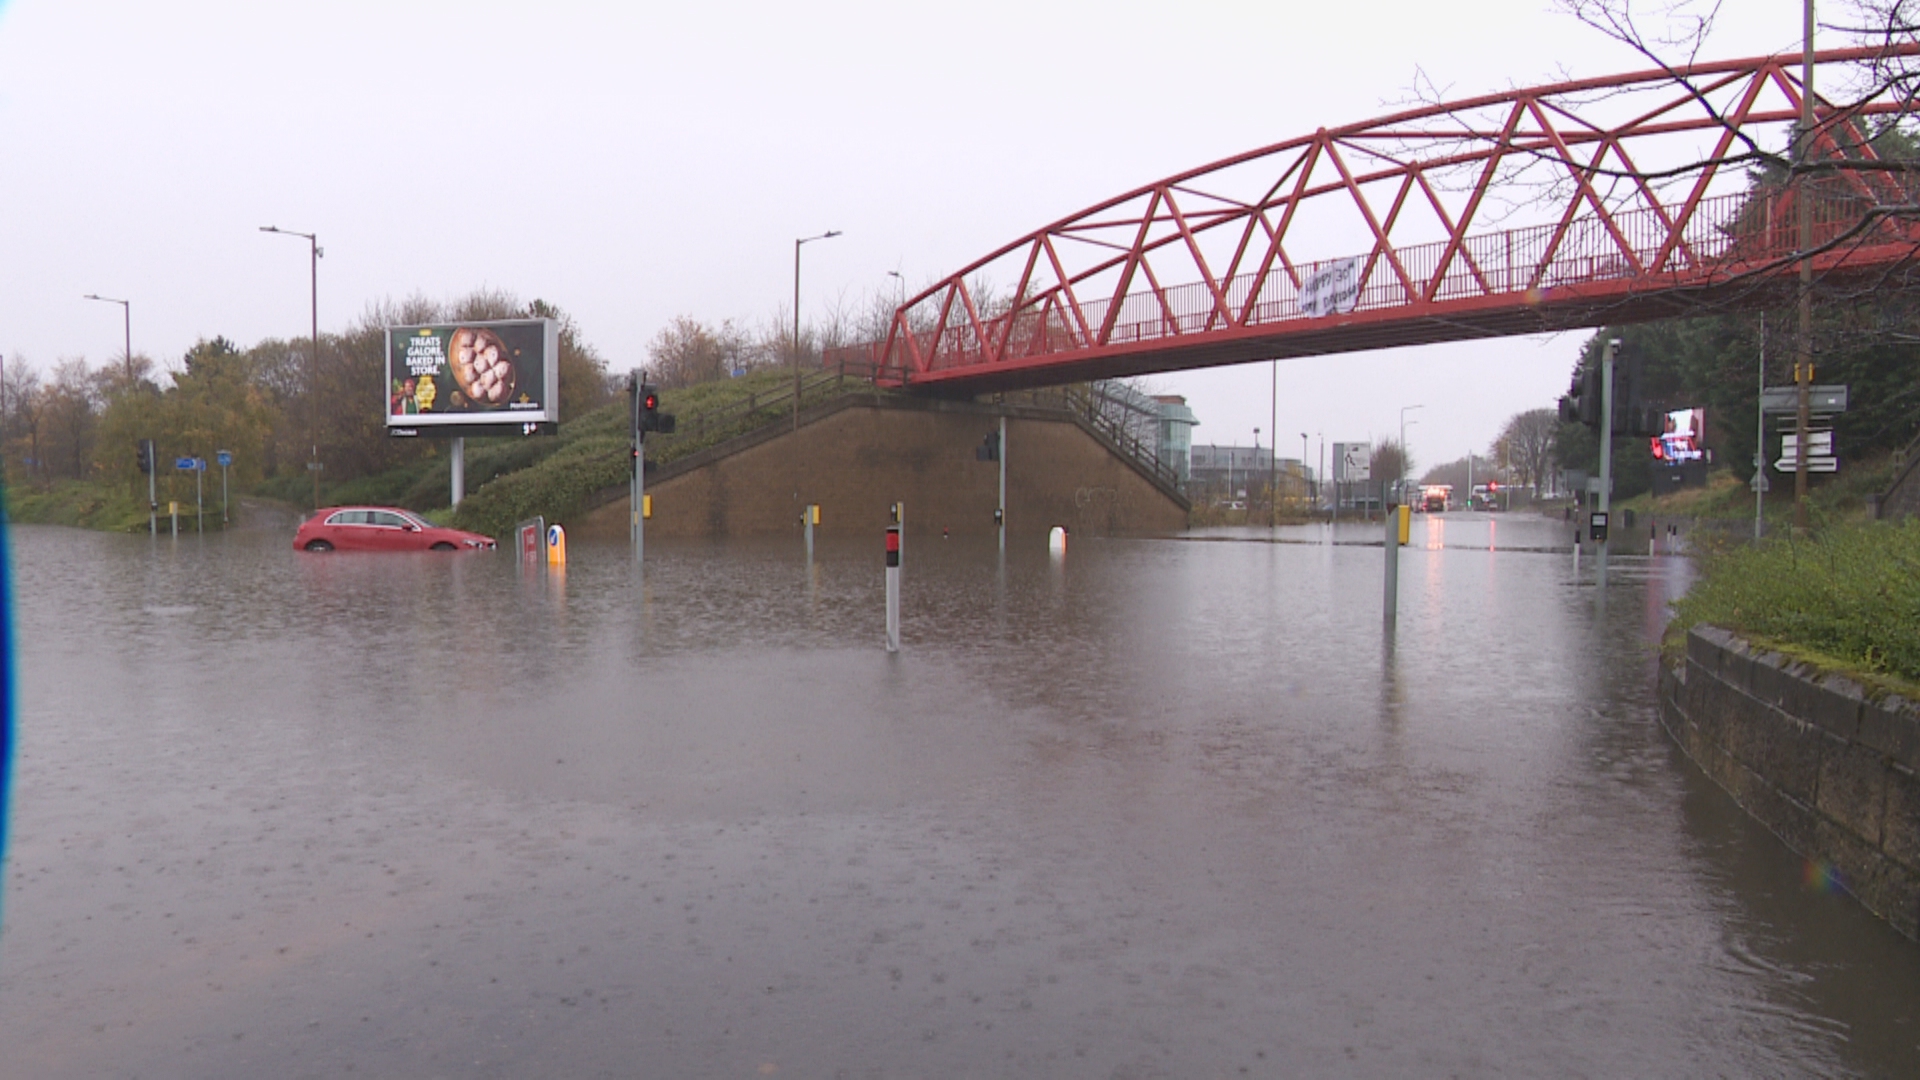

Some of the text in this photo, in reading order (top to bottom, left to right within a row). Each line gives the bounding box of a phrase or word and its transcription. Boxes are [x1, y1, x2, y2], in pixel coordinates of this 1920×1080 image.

[410, 336, 441, 346] TREATS
[406, 355, 446, 366] BAKED IN
[411, 365, 440, 376] STORE.
